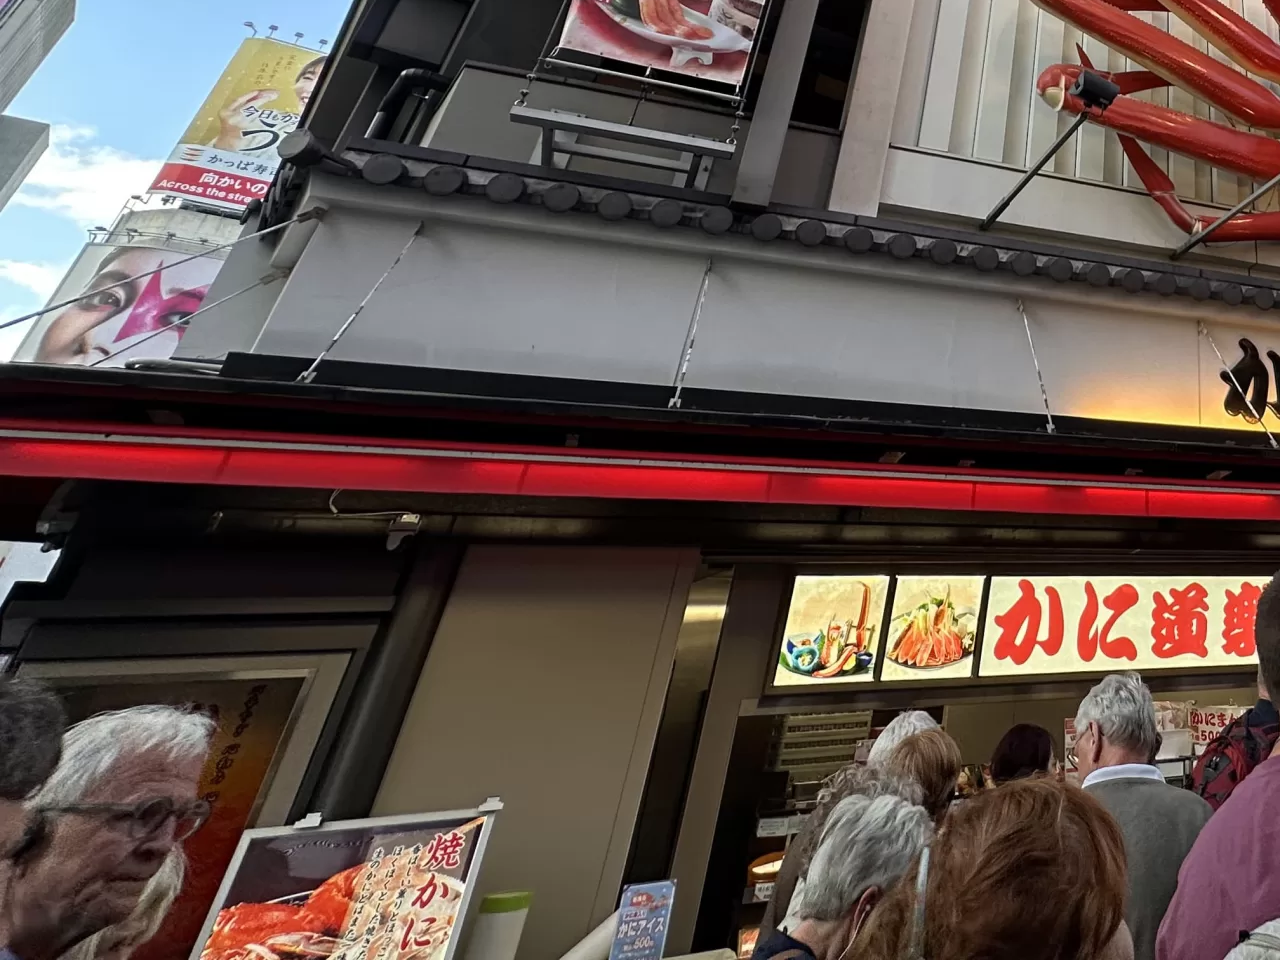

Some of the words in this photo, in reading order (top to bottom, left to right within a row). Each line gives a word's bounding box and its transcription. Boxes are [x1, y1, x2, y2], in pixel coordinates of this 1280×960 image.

[158, 179, 204, 193] Across
[206, 187, 227, 198] the
[401, 832, 464, 951] 焼かに
[617, 917, 664, 939] かにアイス
